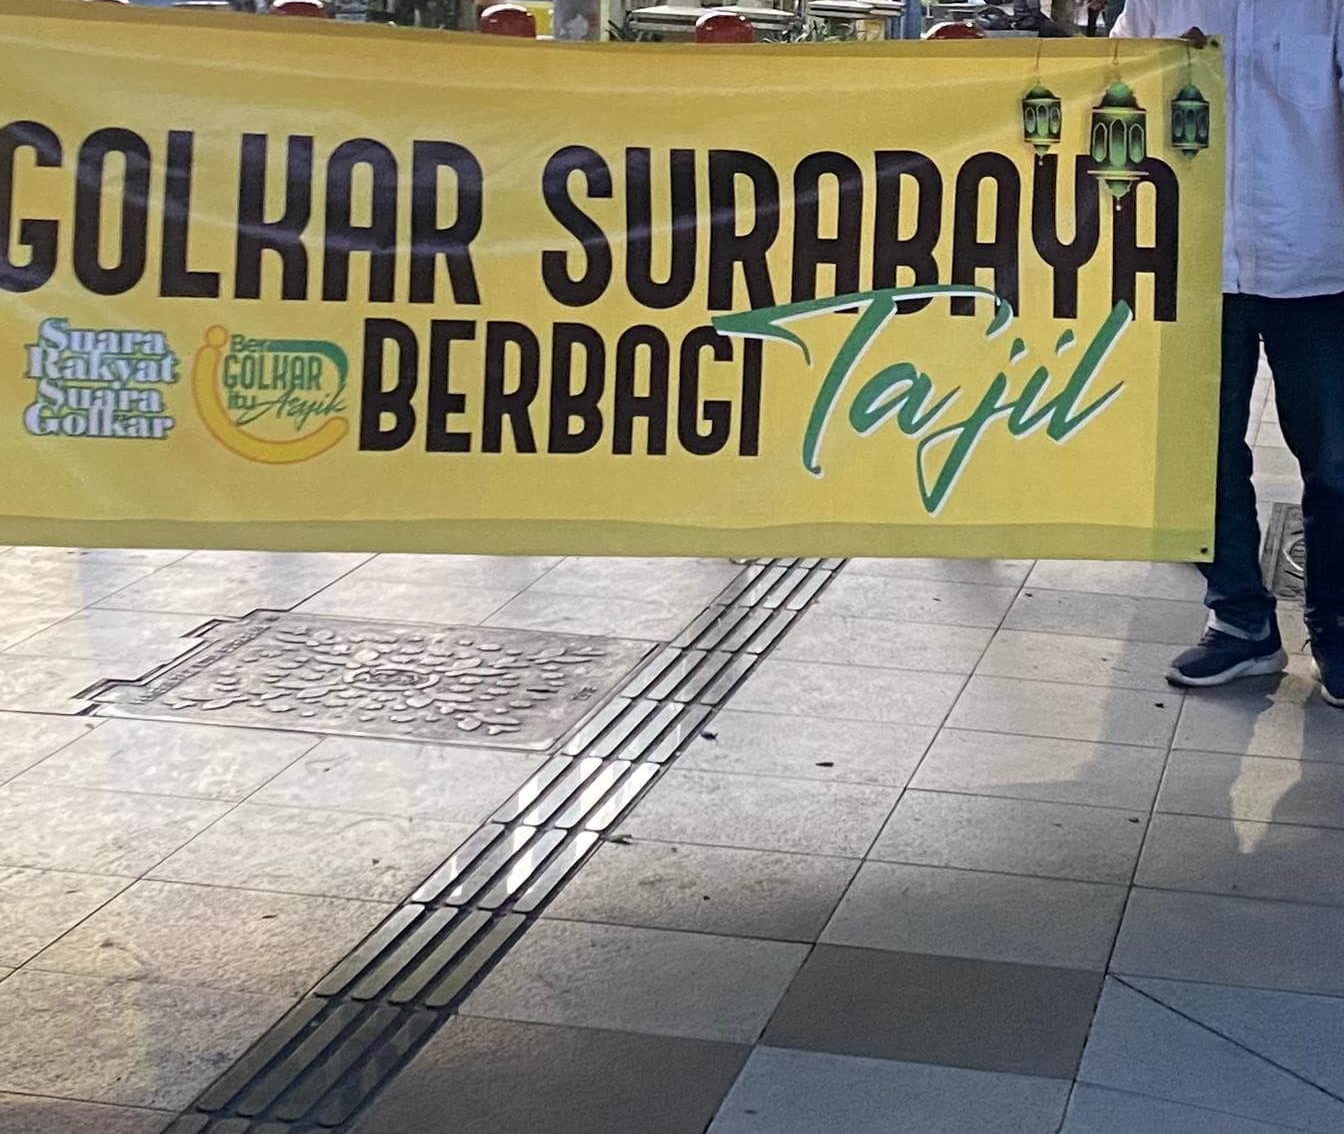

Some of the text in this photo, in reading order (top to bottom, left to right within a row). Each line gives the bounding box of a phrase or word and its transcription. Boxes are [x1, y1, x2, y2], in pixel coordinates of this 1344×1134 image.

[542, 144, 1180, 323] SURABAYA
[39, 318, 168, 353] Suara
[23, 344, 179, 388] Rakyat
[223, 353, 322, 391] GOLKAR
[37, 378, 164, 413] Suara
[360, 317, 763, 456] BERBAGI
[23, 403, 175, 440] Golkar
